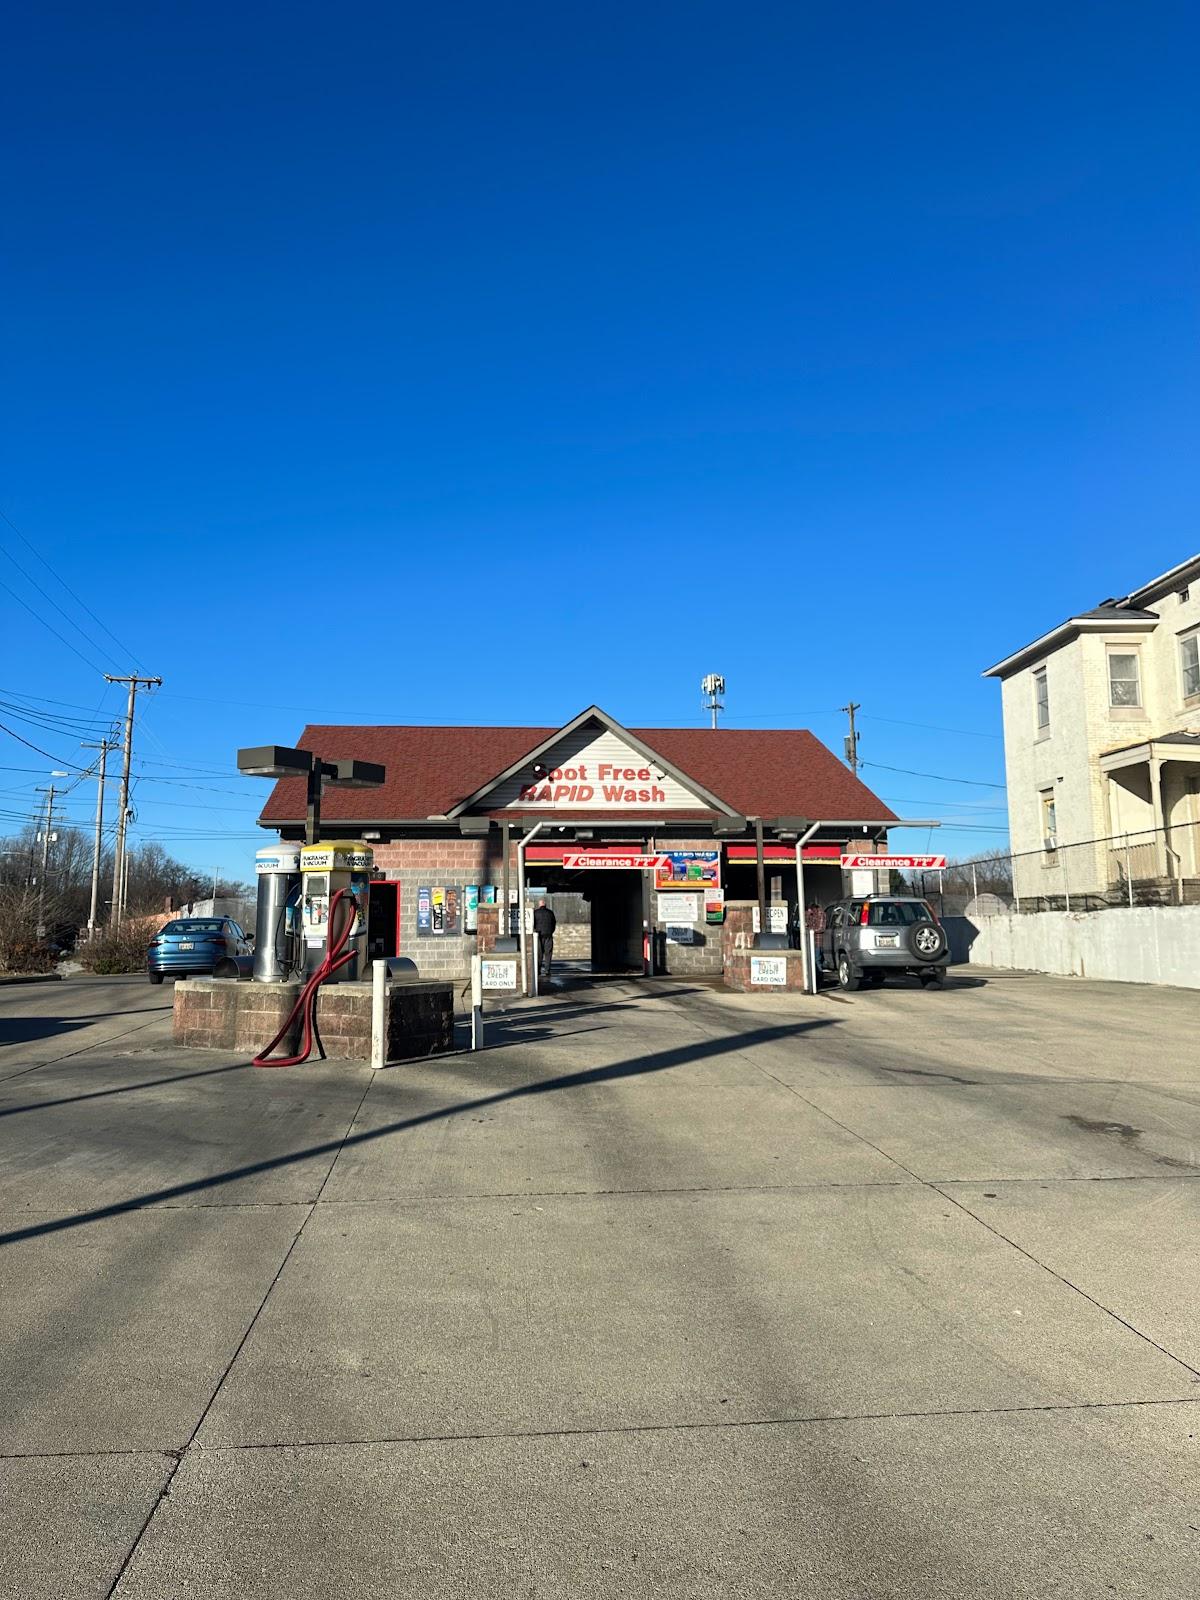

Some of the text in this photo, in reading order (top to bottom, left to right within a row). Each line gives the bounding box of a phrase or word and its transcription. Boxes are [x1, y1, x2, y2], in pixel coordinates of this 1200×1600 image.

[598, 764, 650, 781] Free
[518, 785, 665, 802] RAPID Wash
[577, 858, 632, 867] Clearance
[857, 857, 911, 867] Clearance
